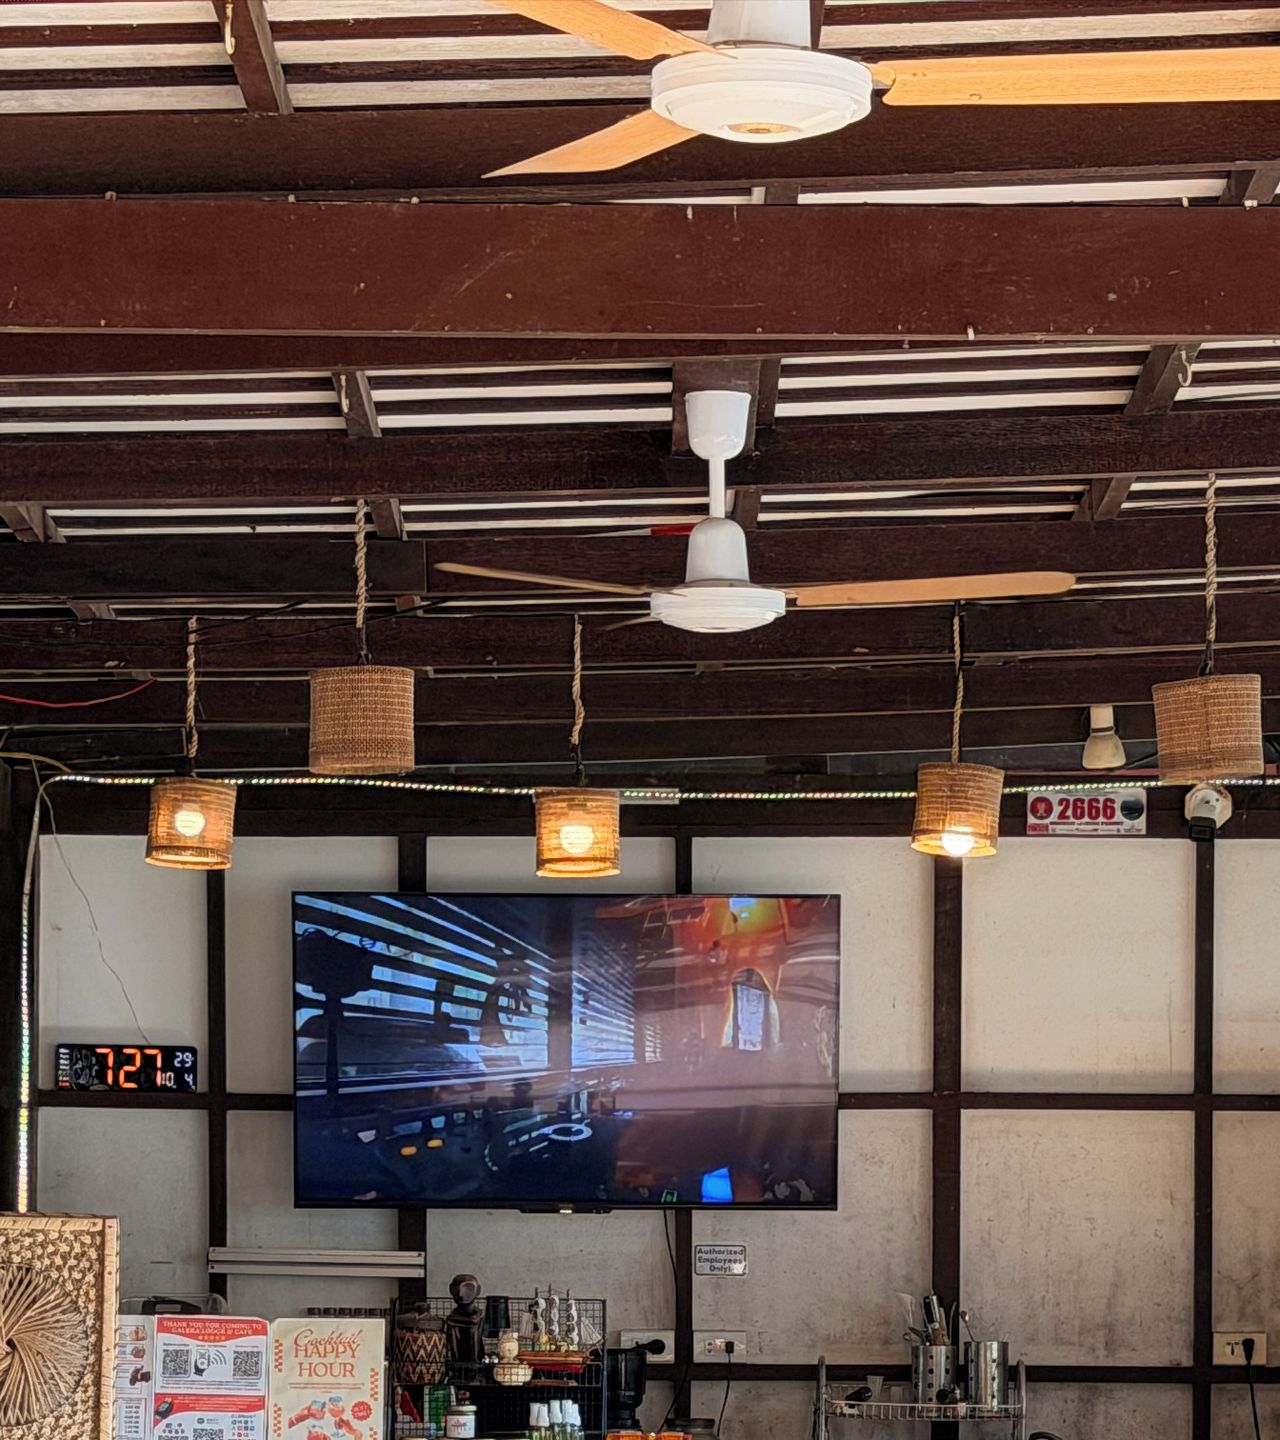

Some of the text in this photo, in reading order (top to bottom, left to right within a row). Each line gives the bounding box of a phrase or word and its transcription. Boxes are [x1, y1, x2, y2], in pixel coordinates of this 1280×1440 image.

[1057, 797, 1116, 820] 2666
[697, 1247, 744, 1256] Authorized
[698, 1256, 743, 1265] Employees
[293, 1328, 363, 1347] Cocktail
[293, 1343, 361, 1358] HAPPY
[297, 1362, 356, 1377] HOUR
